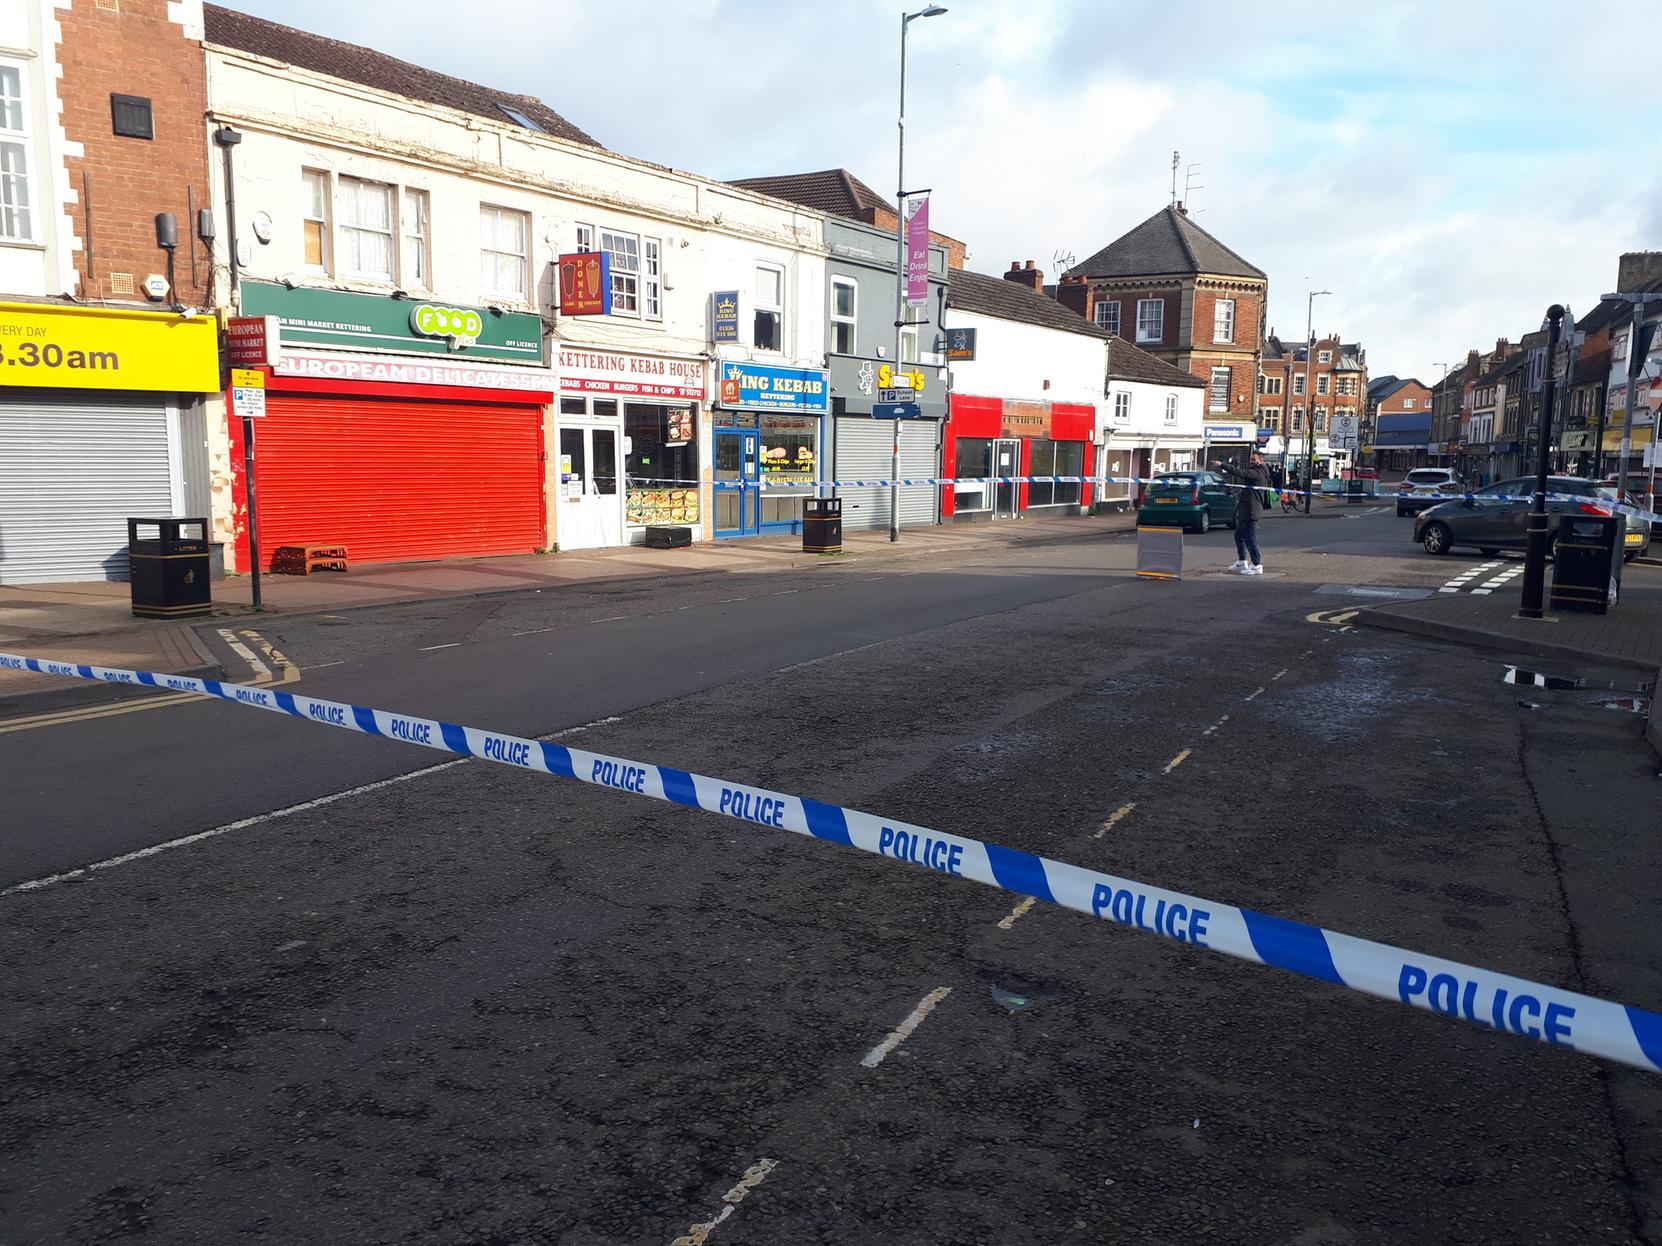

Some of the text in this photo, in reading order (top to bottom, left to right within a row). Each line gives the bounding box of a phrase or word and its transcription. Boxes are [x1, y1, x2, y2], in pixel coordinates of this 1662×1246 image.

[914, 250, 926, 259] Eat
[0, 324, 47, 337] ERY DAY
[229, 323, 264, 336] EUROPEAN
[288, 318, 306, 327] MINI
[307, 320, 335, 330] MARKET
[336, 323, 372, 333] KETTERING
[422, 312, 477, 332] FOOD
[516, 341, 538, 349] LICENCE
[947, 348, 973, 357] Sam's
[0, 342, 119, 370] .30am
[558, 351, 702, 379] KETTERING KEBAB HOUSE
[280, 357, 411, 380] EUROPEAN
[584, 381, 611, 390] CHICKEN
[613, 383, 639, 393] BURGERS
[641, 385, 654, 394] FISH
[660, 386, 676, 395] CHIPS
[773, 377, 823, 394] KEBAB
[1206, 427, 1240, 438] Panasonic
[236, 689, 267, 706] POLICE
[309, 703, 346, 726] POLICE
[391, 718, 432, 745] POLICE
[484, 736, 530, 767] POLICE
[592, 759, 646, 794] POLICE
[720, 788, 785, 828] POLICE
[879, 826, 963, 877] POLICE
[1092, 882, 1211, 948] POLICE
[1398, 963, 1577, 1049] POLICE
